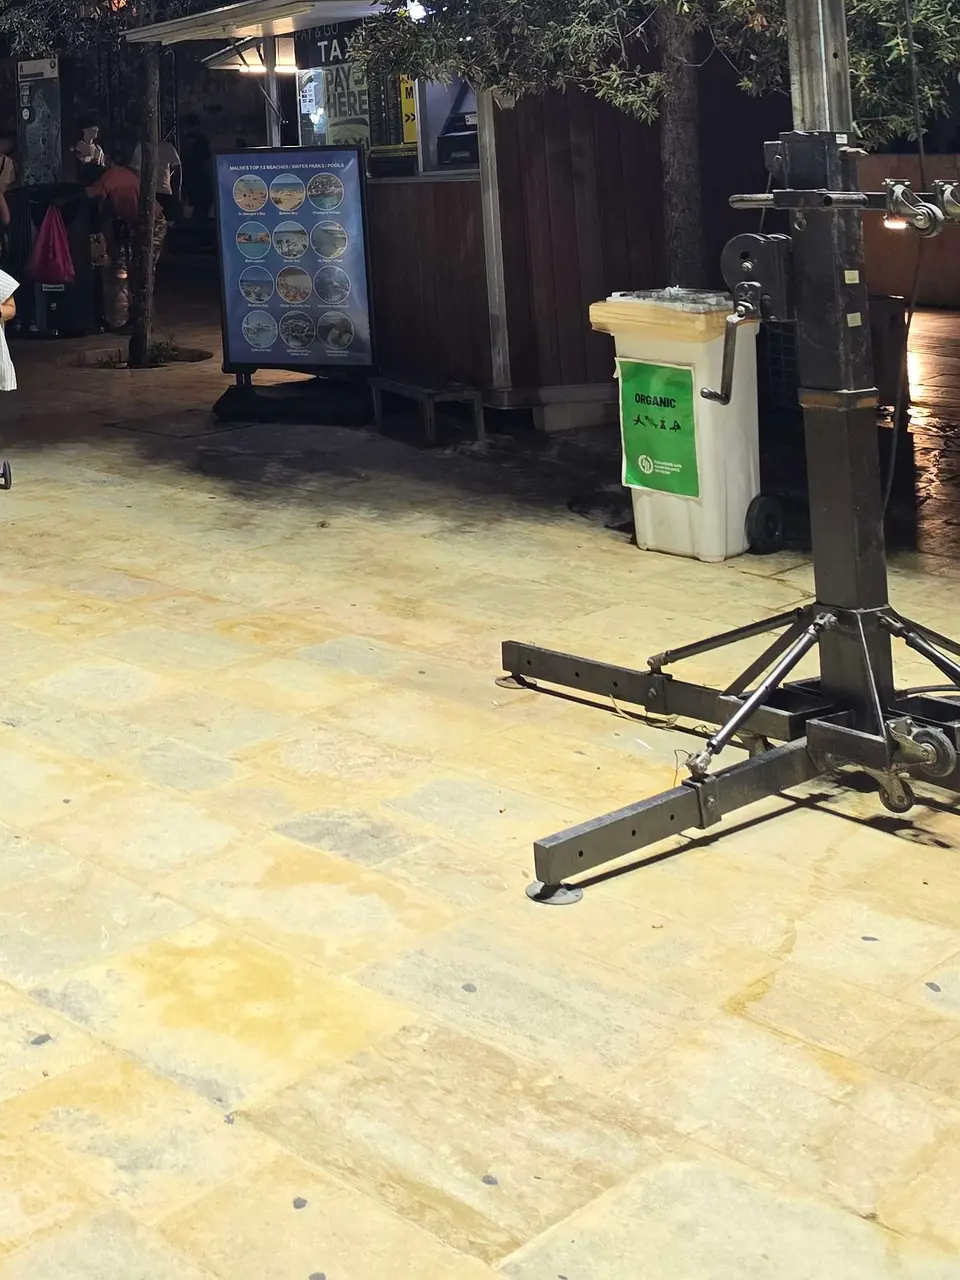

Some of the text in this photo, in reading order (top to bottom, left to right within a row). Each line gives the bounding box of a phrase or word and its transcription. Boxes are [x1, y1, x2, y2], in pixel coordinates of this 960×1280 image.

[315, 27, 321, 38] &
[323, 23, 339, 36] GO
[317, 36, 362, 62] TAX
[325, 65, 352, 93] PAY
[327, 89, 368, 118] HERE
[635, 393, 676, 408] ORGANIC
